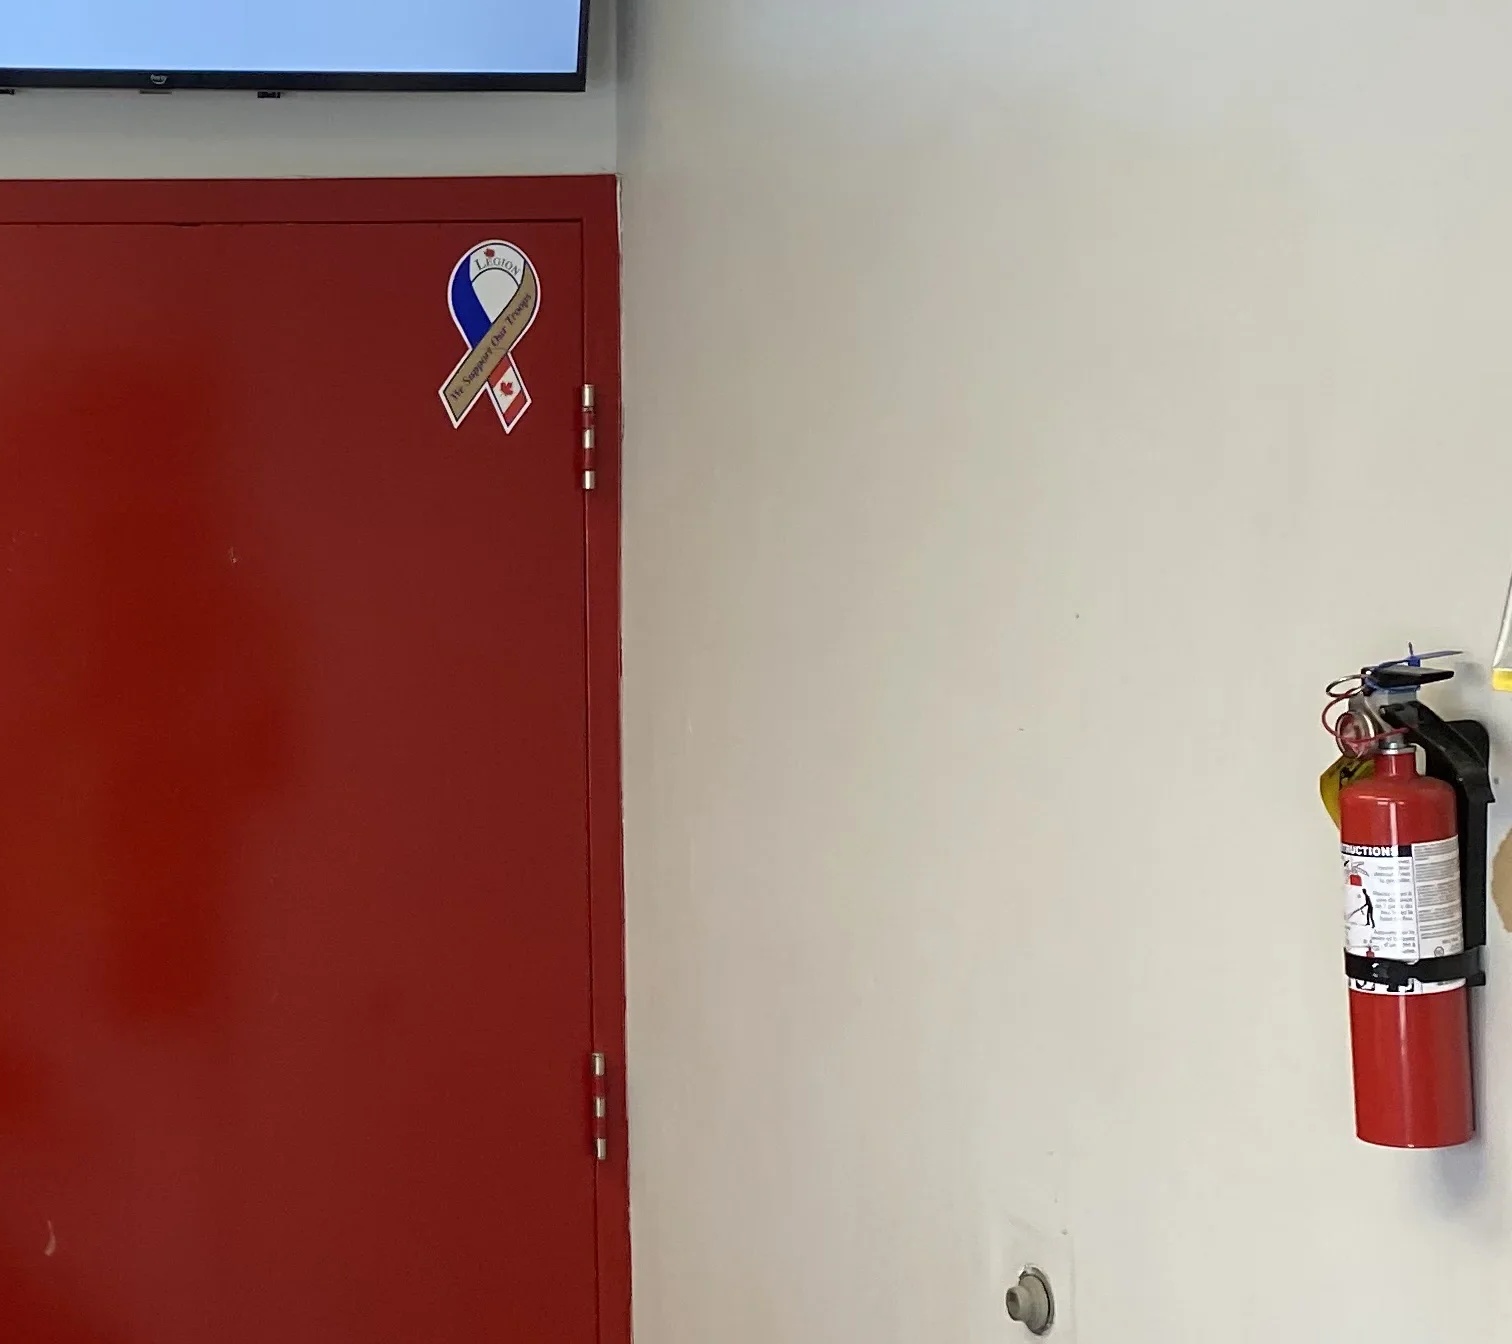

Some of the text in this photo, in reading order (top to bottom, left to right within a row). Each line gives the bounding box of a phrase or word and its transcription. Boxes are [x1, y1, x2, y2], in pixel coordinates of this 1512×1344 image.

[462, 347, 493, 385] Support
[490, 326, 508, 347] Our
[504, 294, 532, 326] Troops
